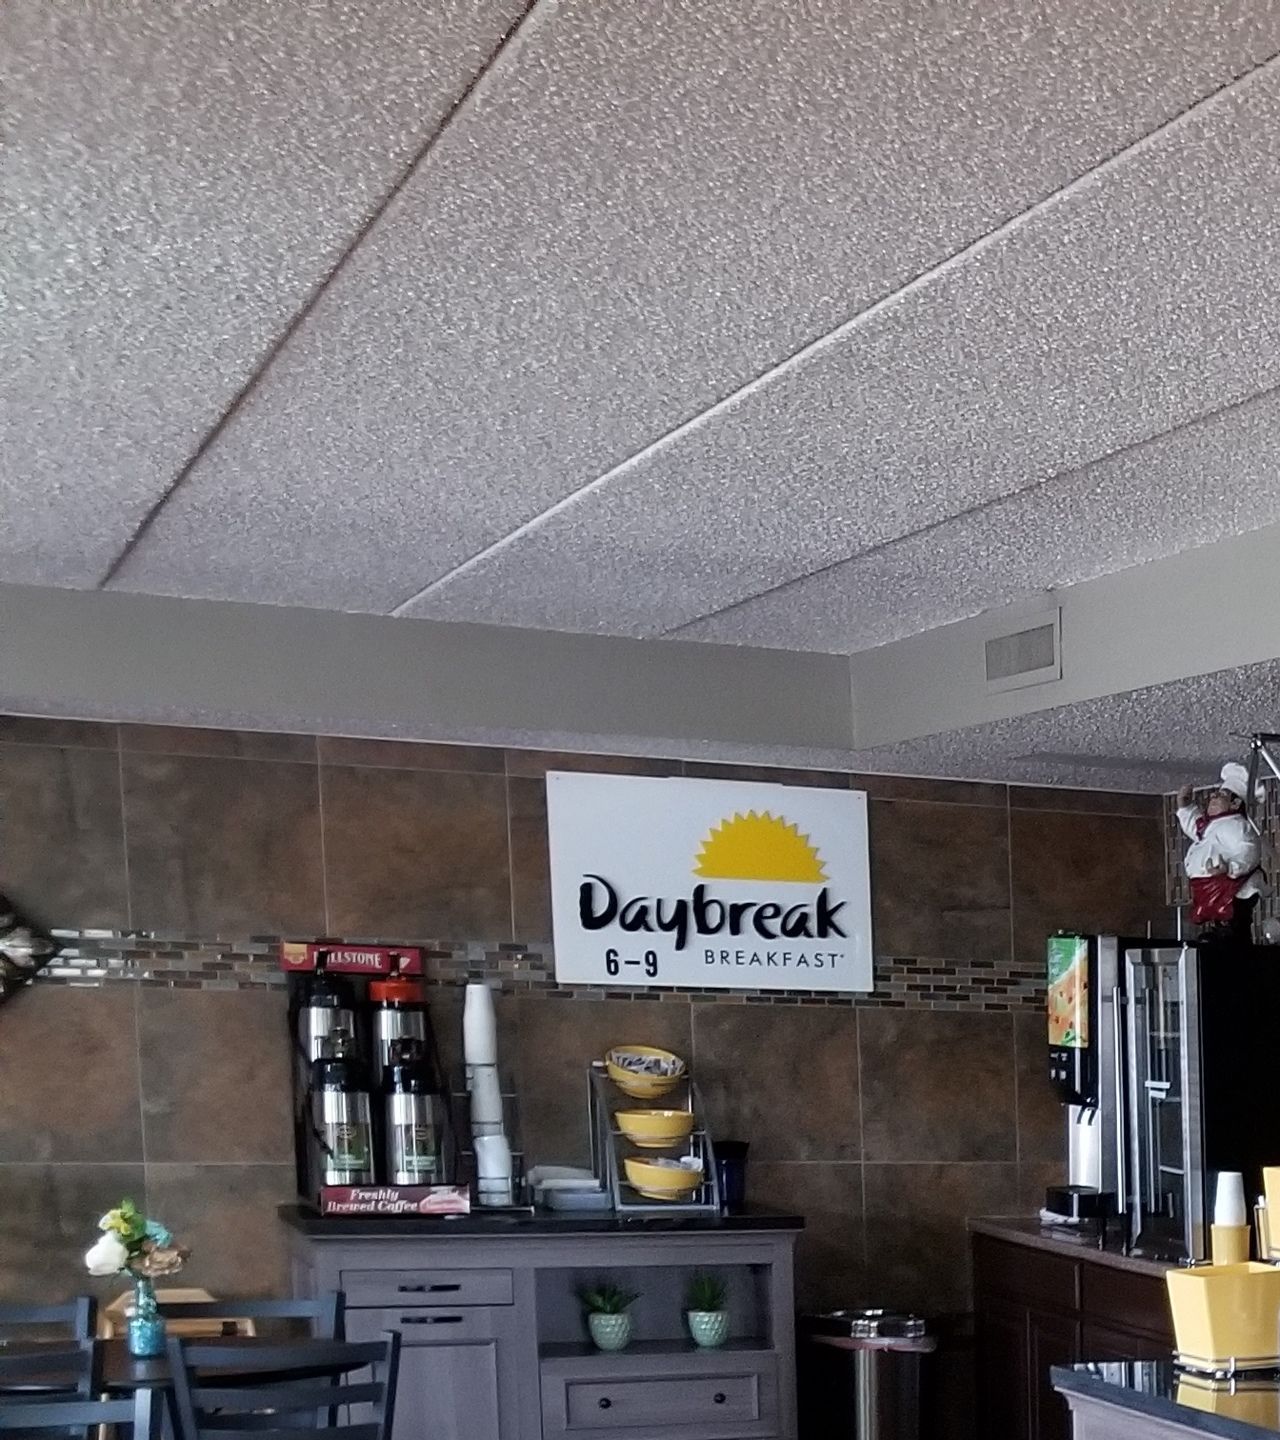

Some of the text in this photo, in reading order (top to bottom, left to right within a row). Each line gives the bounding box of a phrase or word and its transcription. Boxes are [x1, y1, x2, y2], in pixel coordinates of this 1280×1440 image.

[579, 874, 848, 951] Daybreak
[704, 949, 841, 969] BREAKFAST
[350, 1188, 401, 1202] Freshly
[326, 1200, 418, 1214] Brewed Coffee
